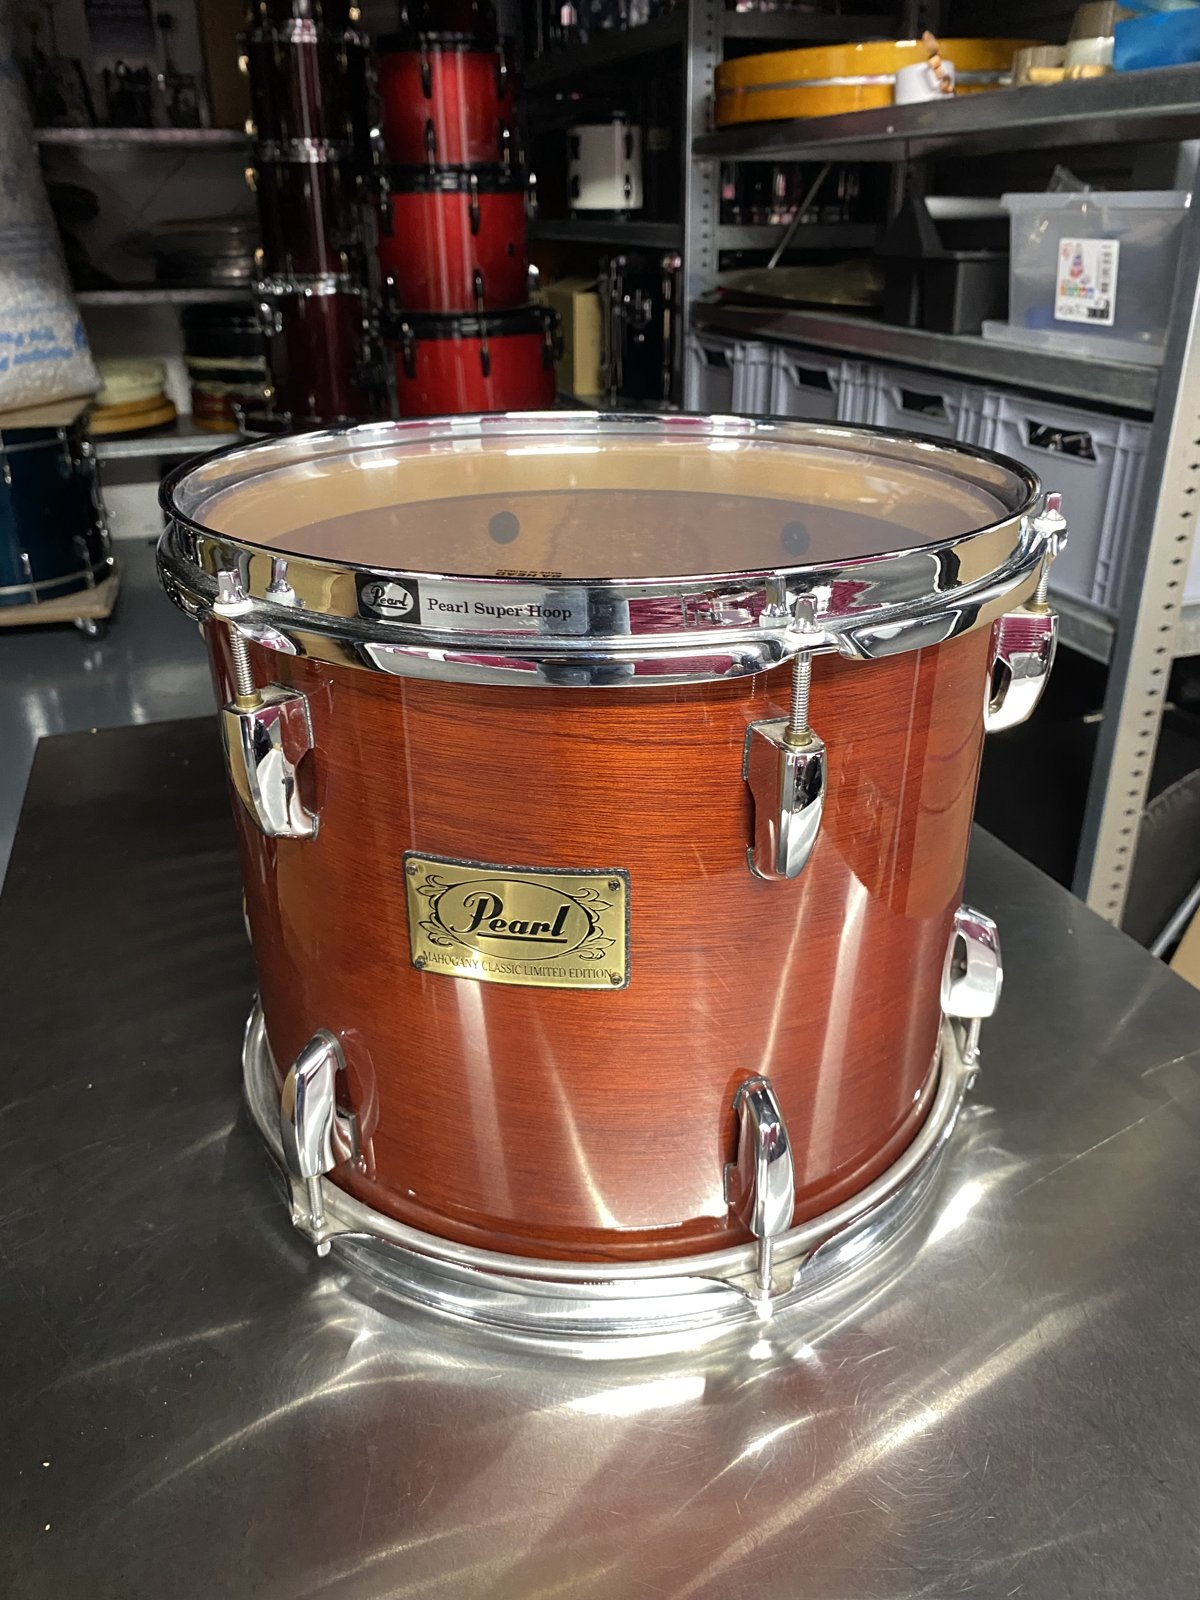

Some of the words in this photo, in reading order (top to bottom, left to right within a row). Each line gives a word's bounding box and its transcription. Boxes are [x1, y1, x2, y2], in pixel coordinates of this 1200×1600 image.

[370, 585, 408, 610] Pearl
[427, 598, 469, 614] Pearl
[474, 602, 523, 618] Super
[528, 605, 572, 620] Hoop
[450, 891, 572, 938] Pearl
[422, 950, 479, 970] MAHOGANY
[482, 959, 523, 975] CLASSIC
[524, 965, 567, 977] LIMITED
[569, 968, 613, 980] EDITION
